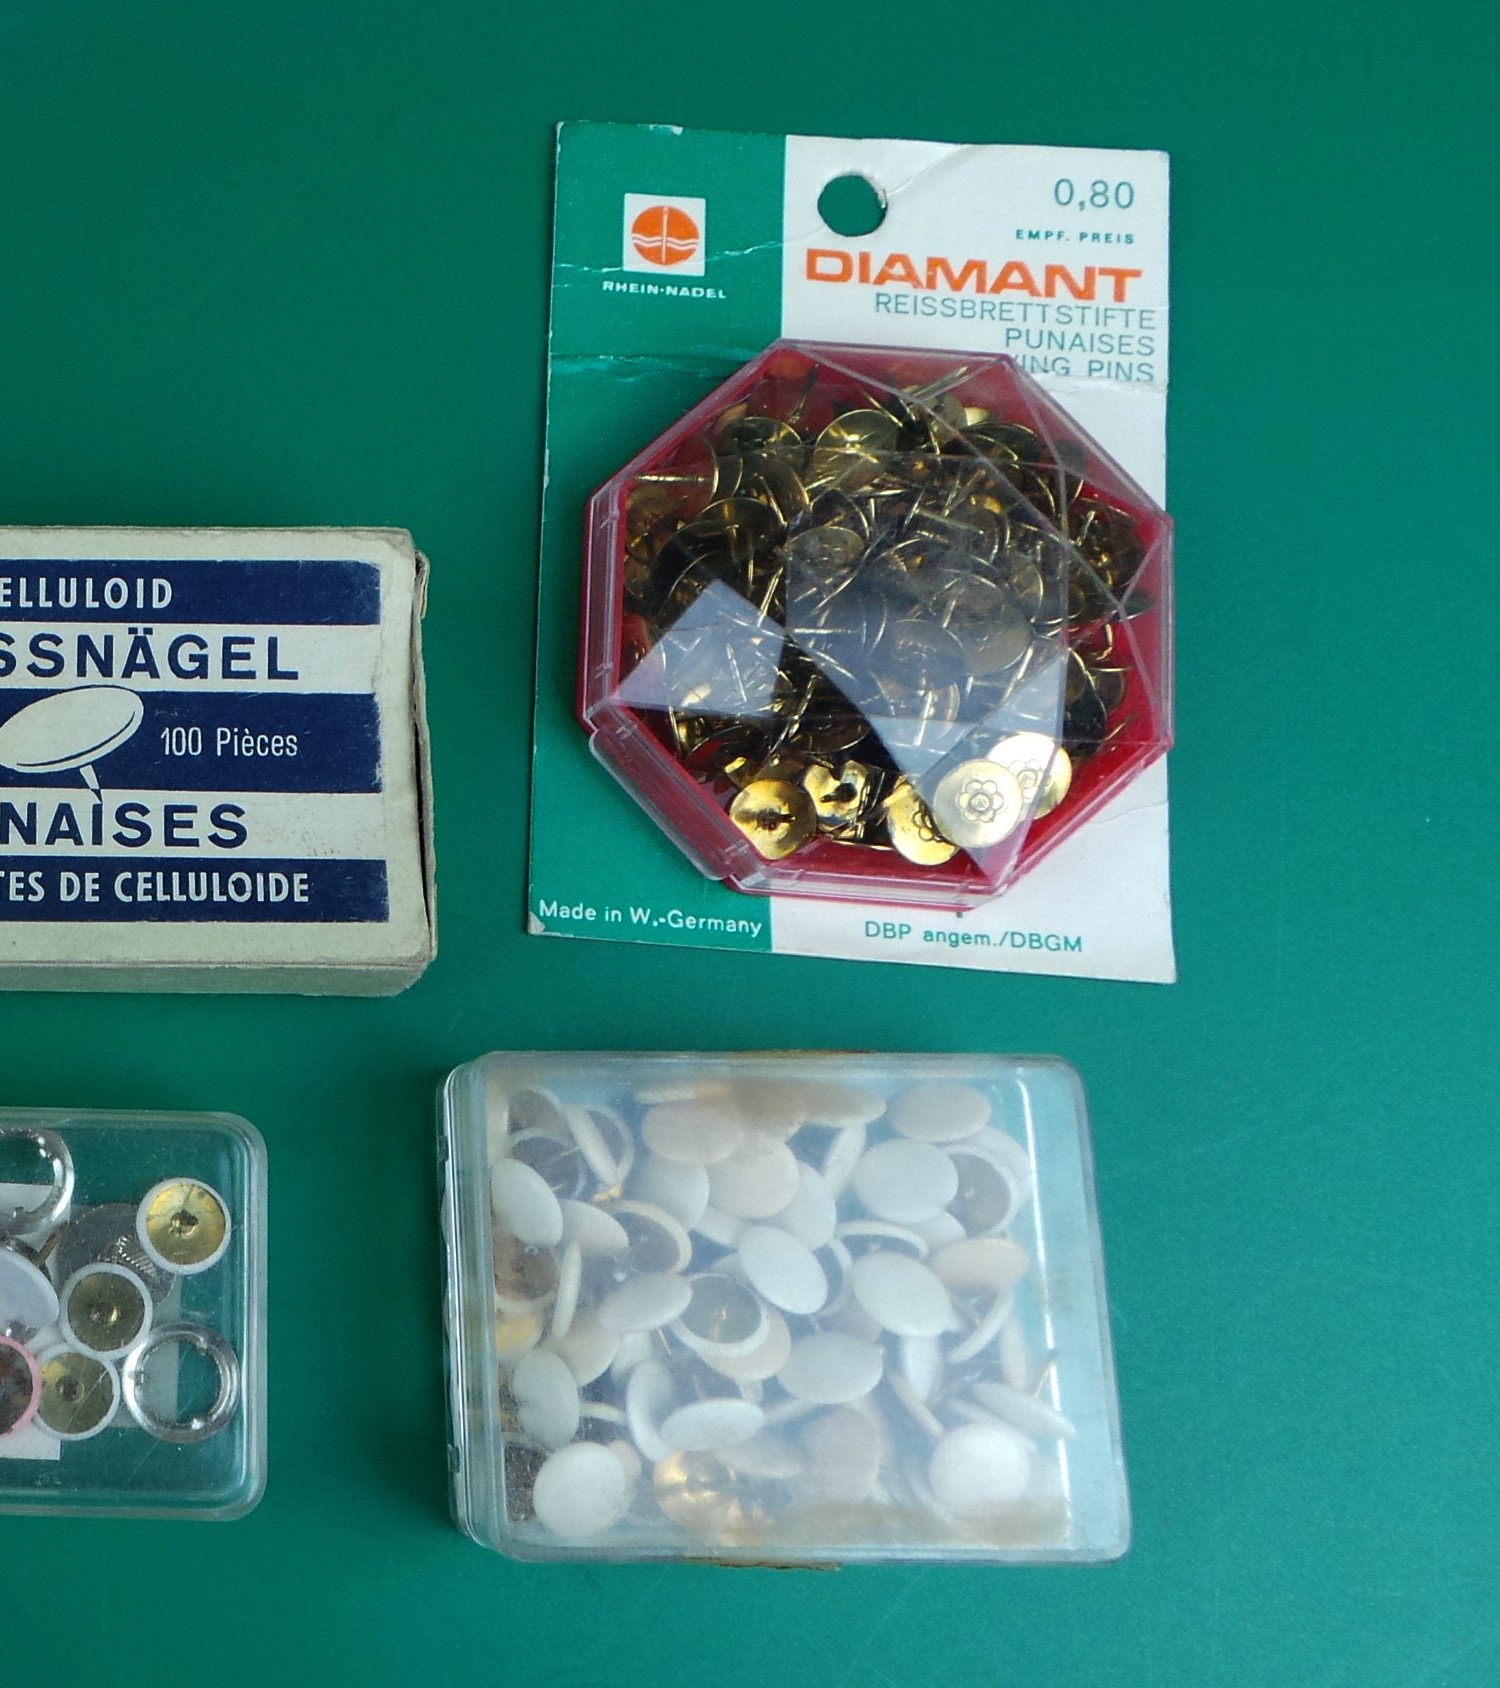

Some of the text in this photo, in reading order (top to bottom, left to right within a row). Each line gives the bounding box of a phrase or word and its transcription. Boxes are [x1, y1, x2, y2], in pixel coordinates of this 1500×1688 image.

[1053, 178, 1135, 211] 0,80
[1015, 229, 1135, 245] EMPF. PREIS
[806, 247, 1143, 304] DIAMANT
[875, 292, 1156, 331] REISSBRETTSTIFTE
[1005, 326, 1155, 356] PUNAISES
[1088, 359, 1155, 382] PINS
[160, 726, 300, 758] 100 Pièces
[60, 869, 101, 902] DE
[114, 871, 310, 904] CELLULOIDE
[538, 899, 763, 939] Made in W.-Germany
[864, 920, 1083, 954] DBP angem./DBGM
